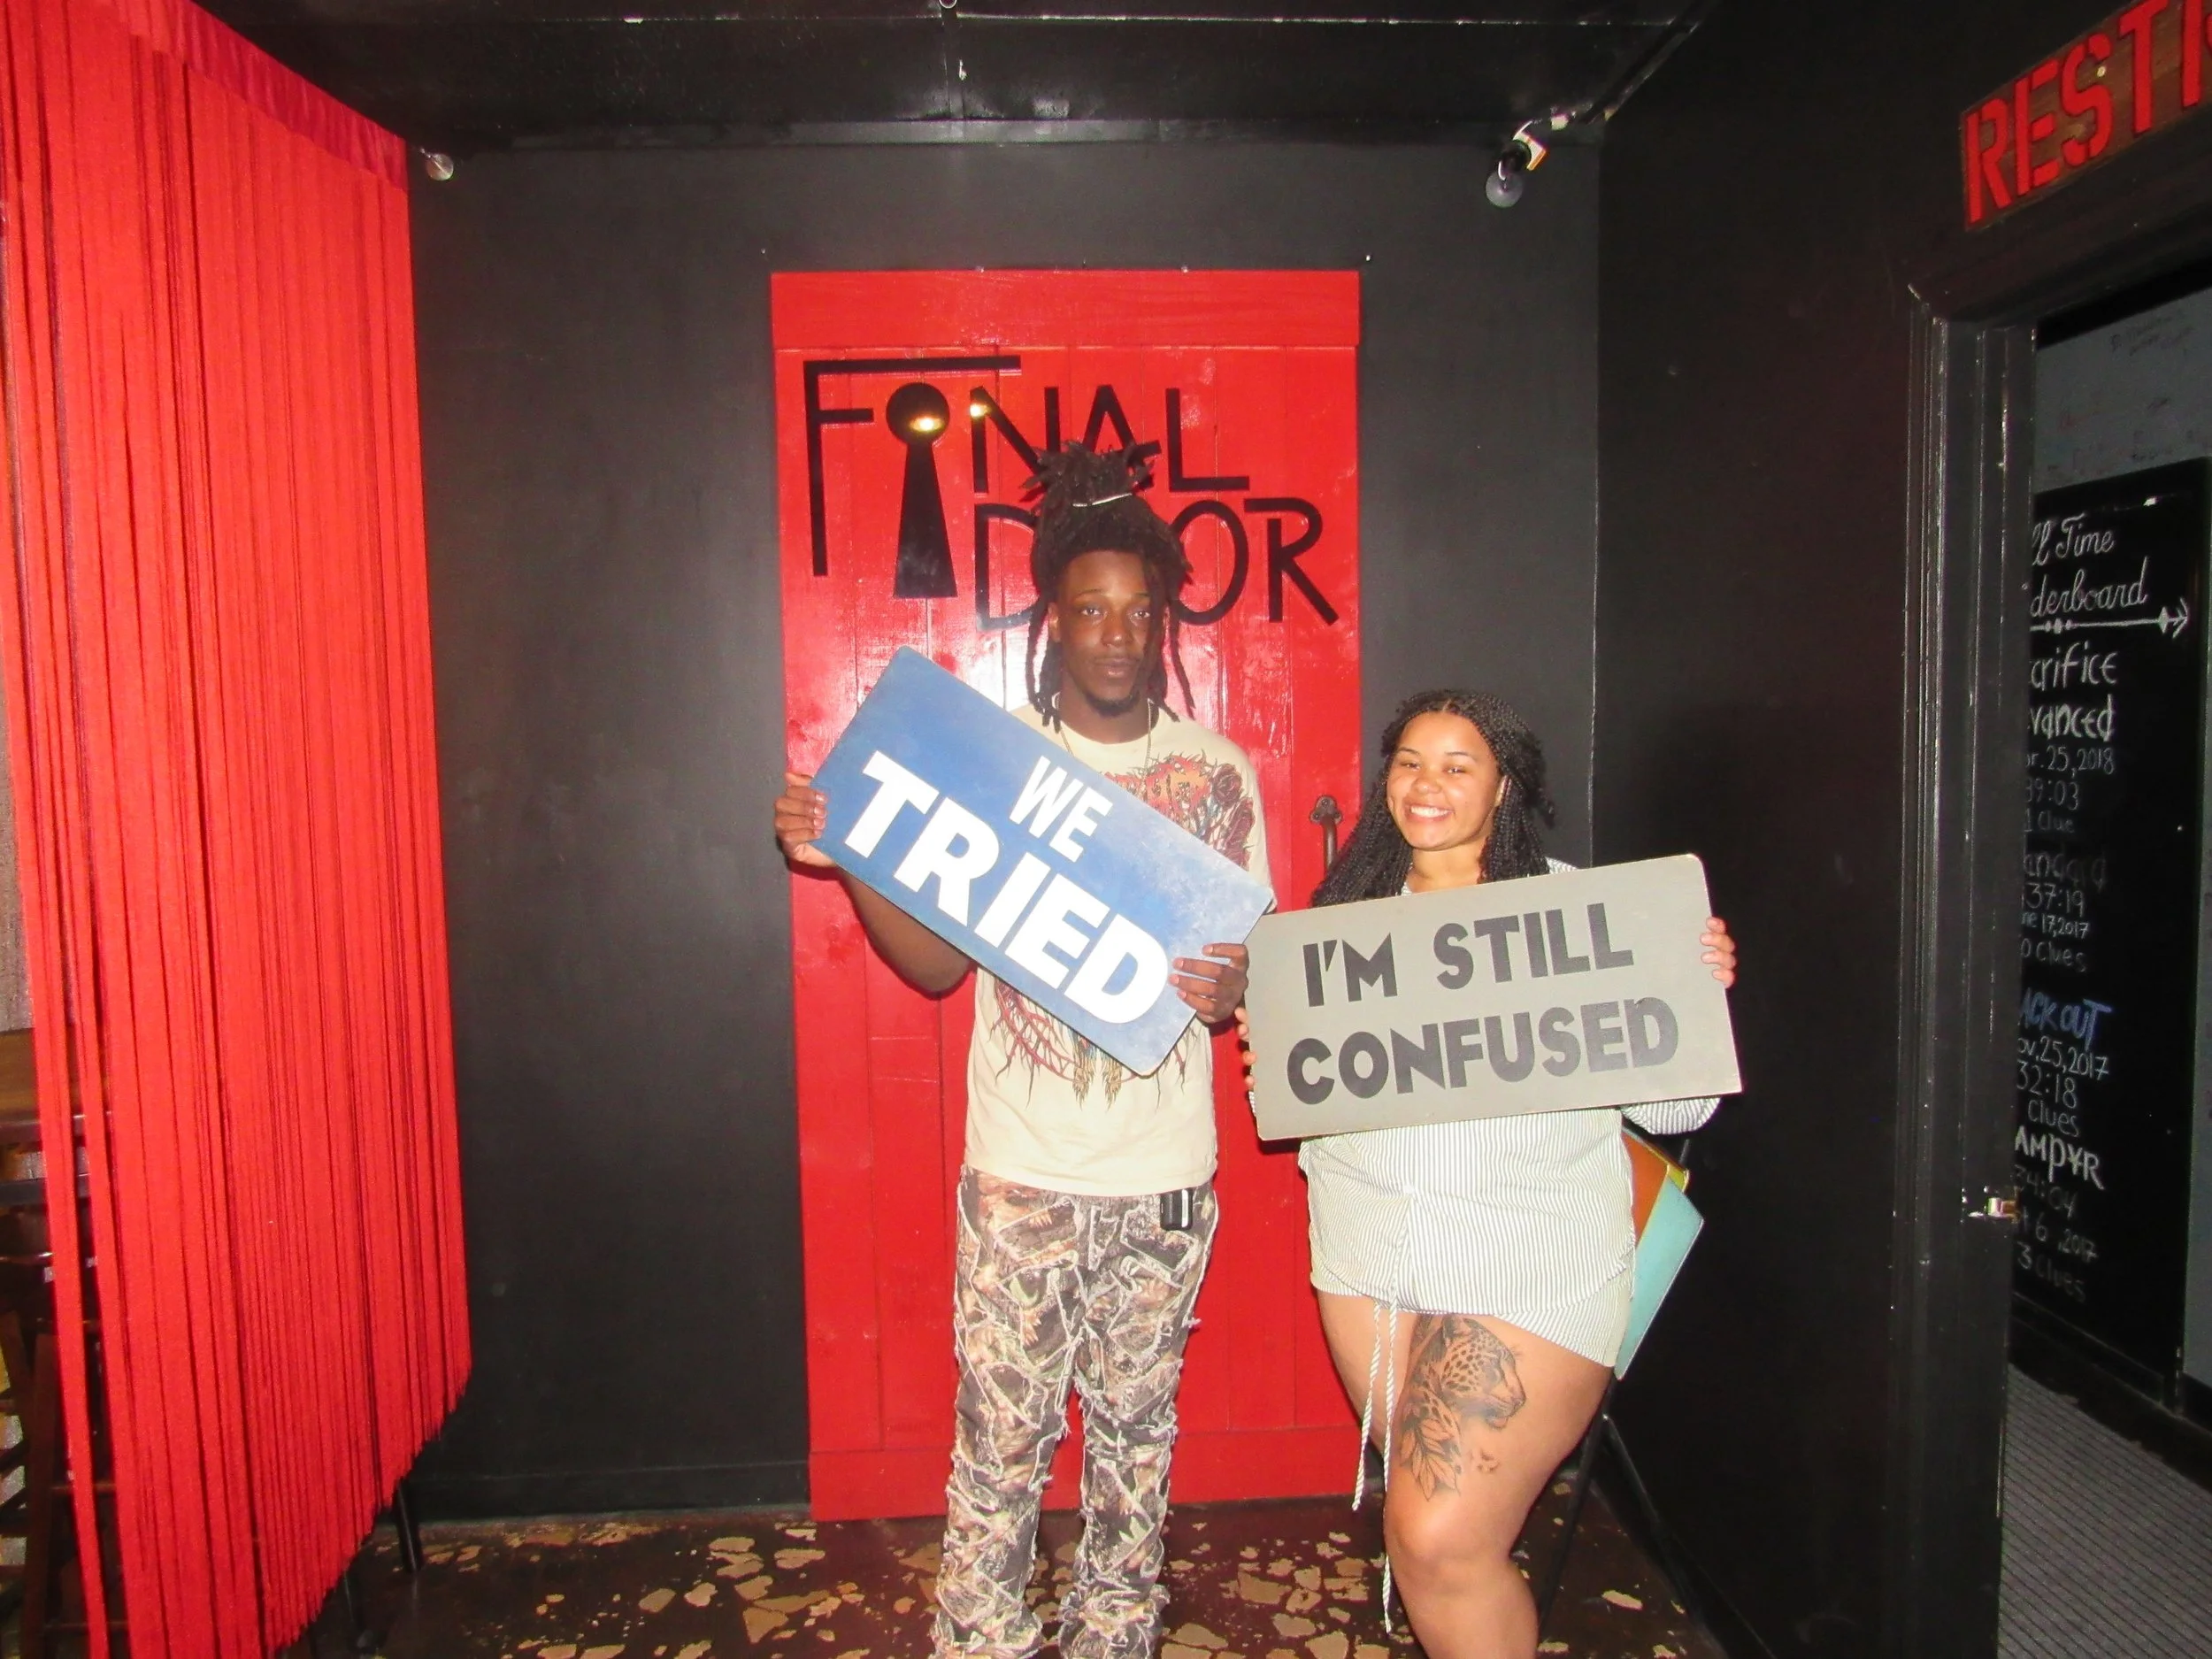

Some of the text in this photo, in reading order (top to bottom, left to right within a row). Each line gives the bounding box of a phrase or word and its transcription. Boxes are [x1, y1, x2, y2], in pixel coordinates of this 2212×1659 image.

[973, 497, 1340, 630] DOR
[2031, 511, 2116, 566] ll Time
[2030, 555, 2149, 618] derboard
[2030, 640, 2118, 691] crifice
[2027, 693, 2116, 742] vanced
[1009, 756, 1113, 863] WE
[843, 750, 1168, 1024] TRIED
[2024, 842, 2107, 893] andard
[1302, 902, 1634, 1007] I'M STILL
[1286, 996, 1679, 1105] CONFUSED
[2017, 1060, 2078, 1110] 32:18
[2015, 1125, 2106, 1190] AMPYR
